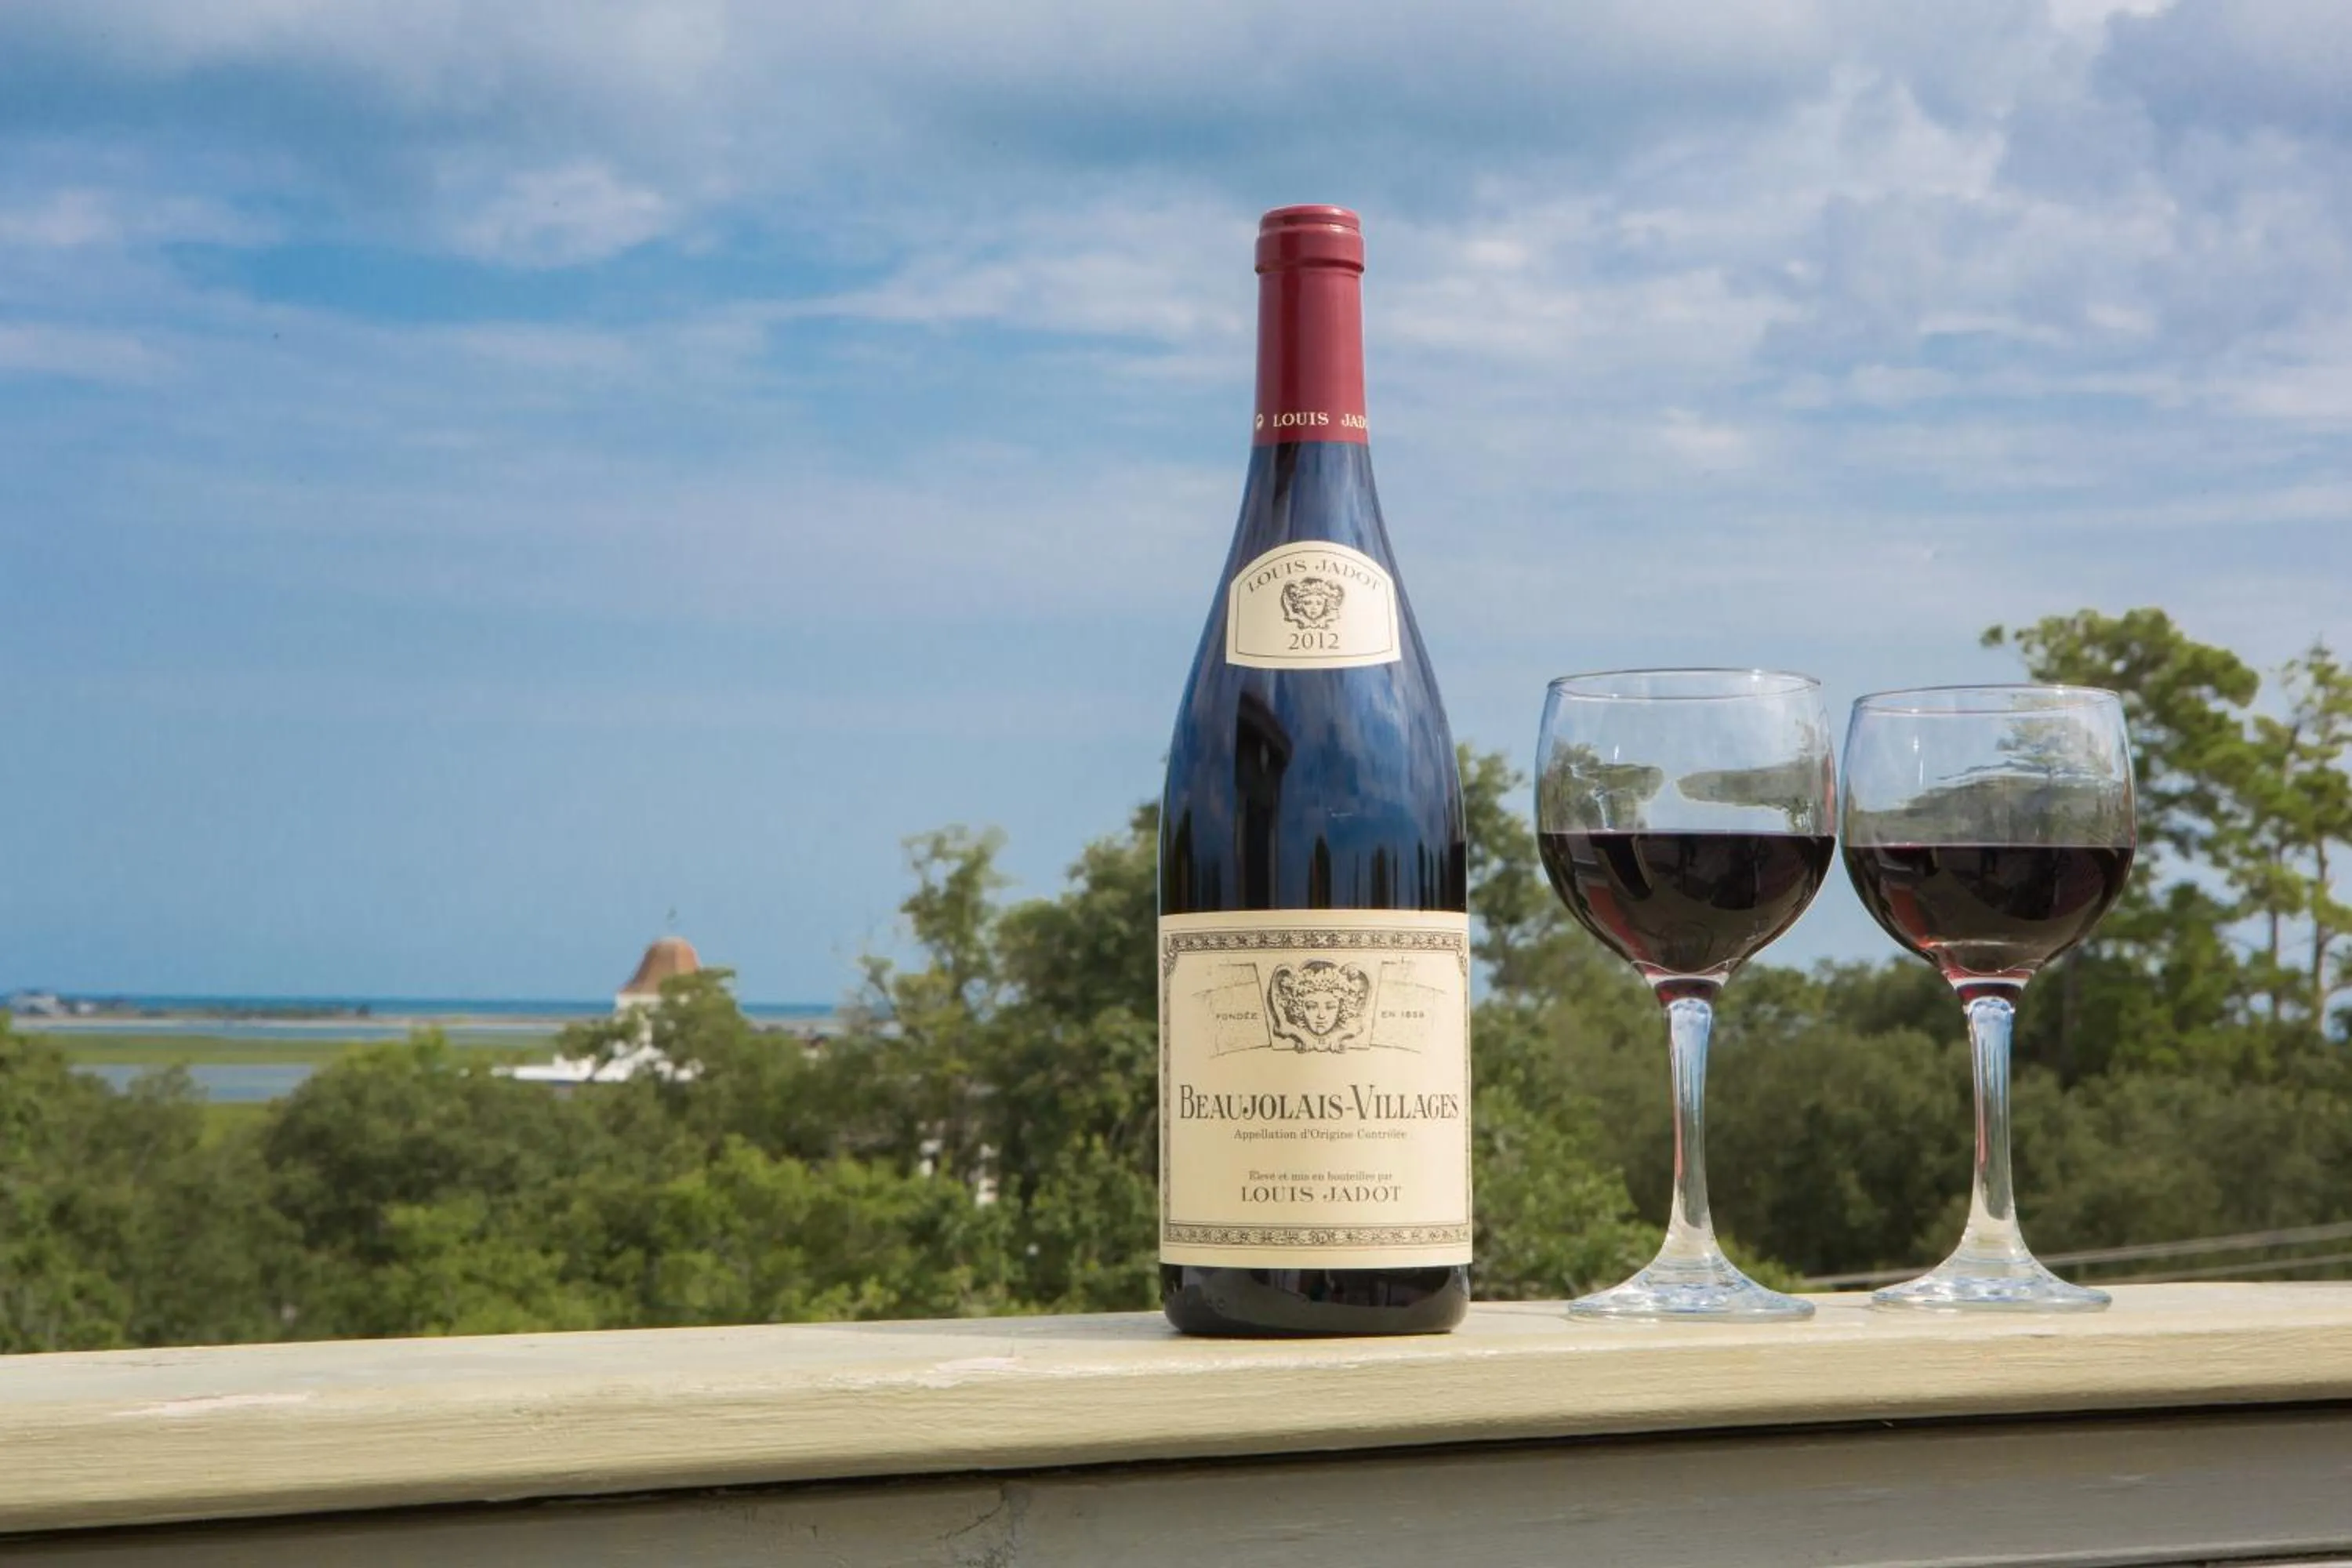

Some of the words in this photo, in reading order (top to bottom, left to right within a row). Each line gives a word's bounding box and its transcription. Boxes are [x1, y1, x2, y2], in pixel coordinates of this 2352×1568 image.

[1273, 412, 1329, 428] LOUIS
[1247, 560, 1307, 593] LOUIS
[1315, 559, 1381, 590] JADOT
[1287, 633, 1340, 650] 2012
[1179, 1084, 1459, 1120] BEAUJOLAIS-VILLAGES
[1233, 1128, 1296, 1142] Appellation
[1300, 1128, 1353, 1142] d'Origine
[1241, 1186, 1314, 1203] LOUIS
[1323, 1185, 1402, 1202] JADOT
